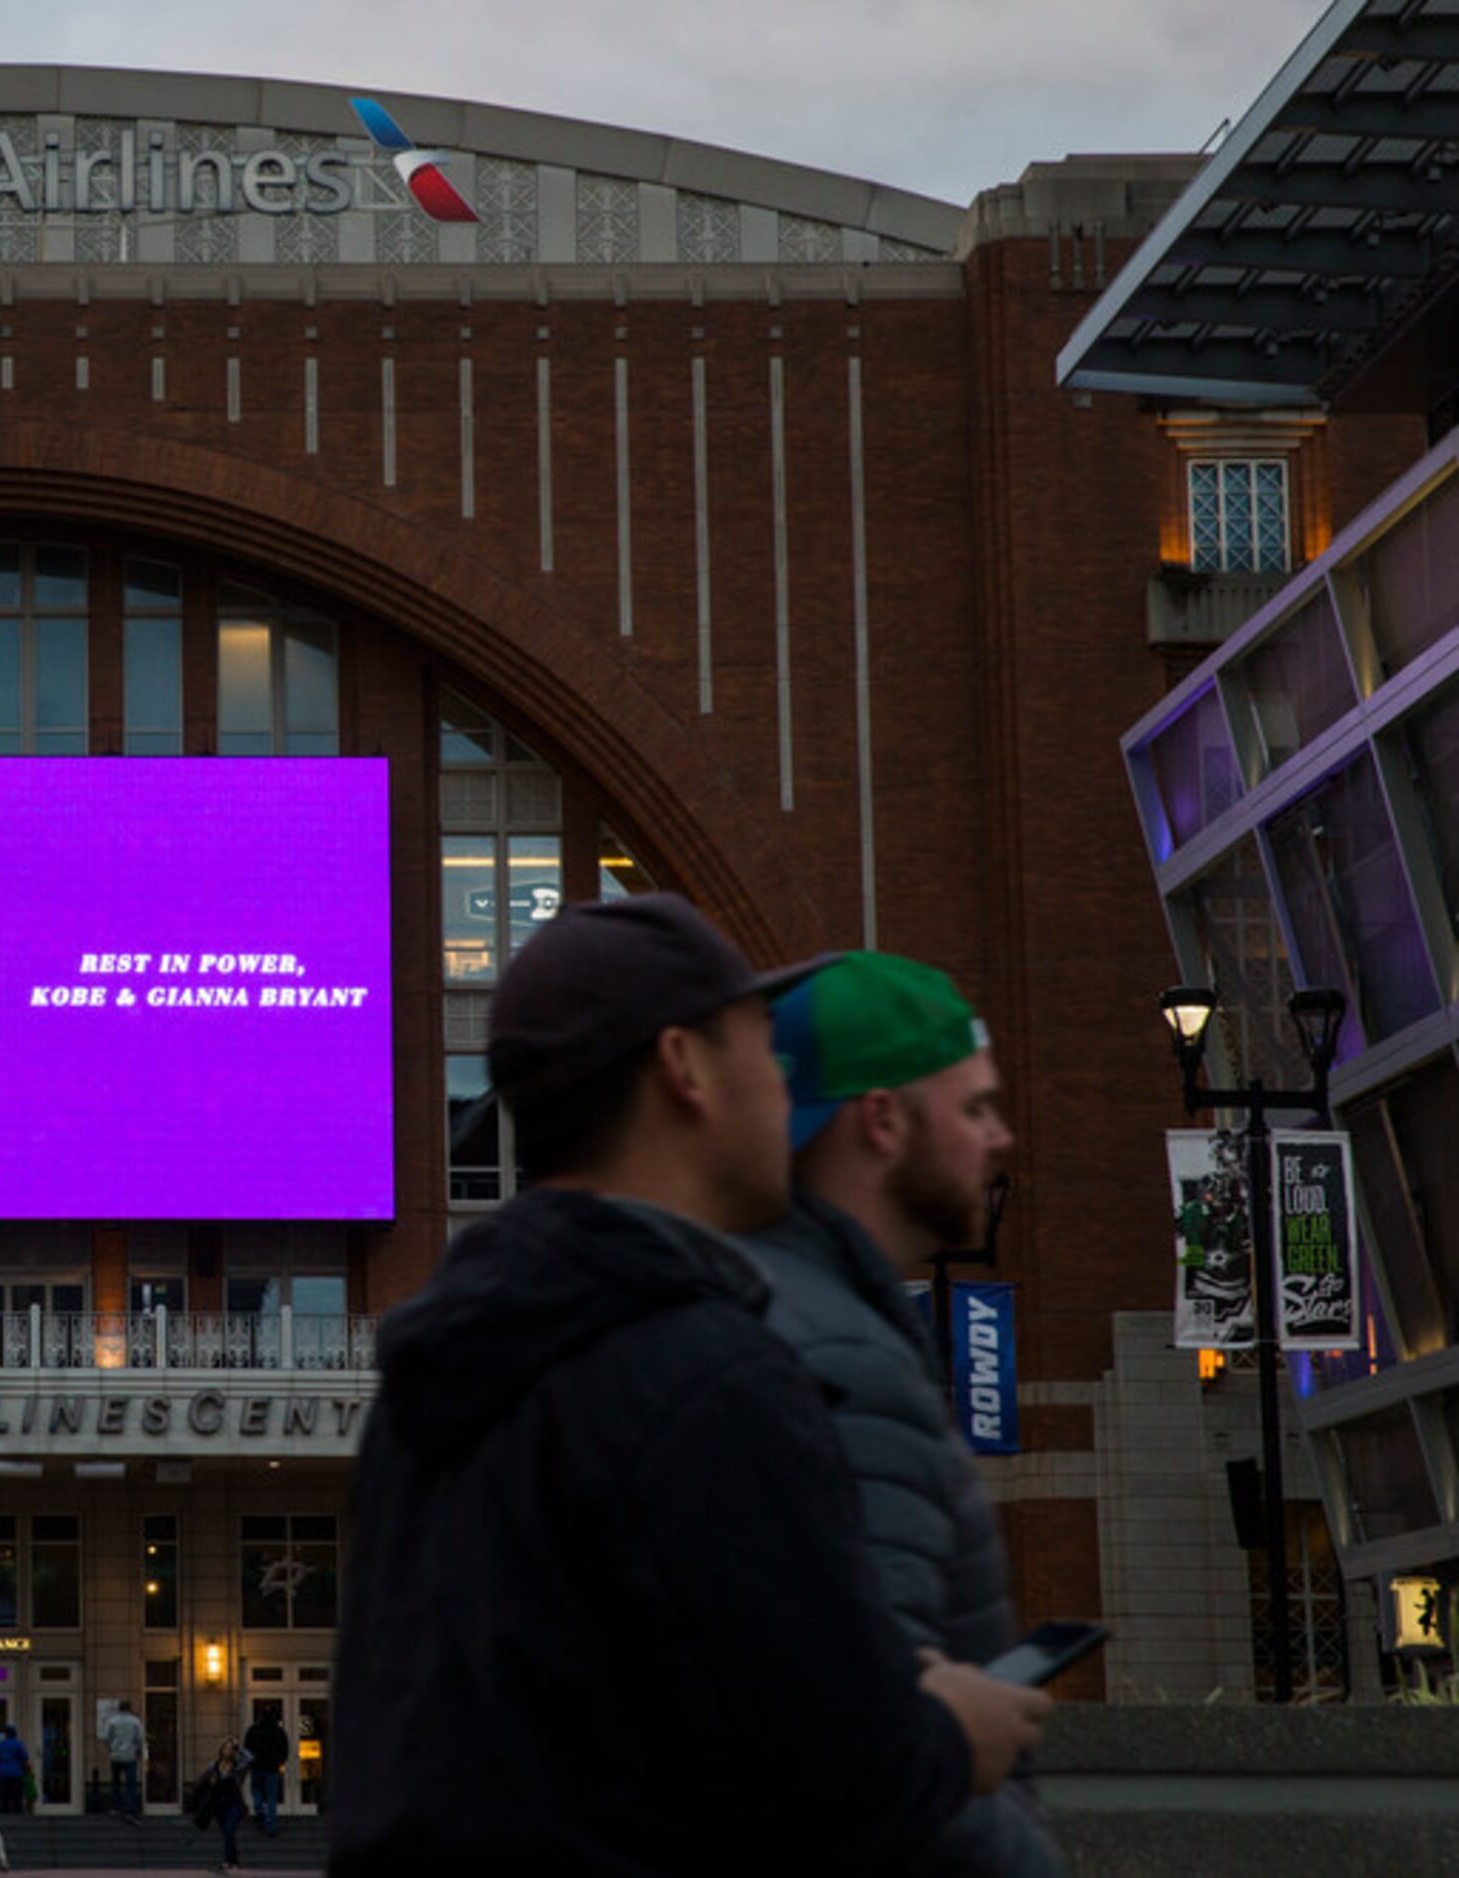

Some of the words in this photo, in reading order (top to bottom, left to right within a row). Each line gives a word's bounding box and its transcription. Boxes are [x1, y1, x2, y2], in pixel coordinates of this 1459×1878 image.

[80, 953, 152, 973] REST
[158, 953, 191, 973] IN
[199, 953, 305, 977] POWER,
[30, 986, 107, 1007] KOBE
[116, 987, 136, 1007] &
[147, 986, 250, 1007] GIANNA
[259, 986, 368, 1007] BRYANT
[1284, 1156, 1303, 1183] BE
[1284, 1184, 1329, 1215] LOUD.
[1286, 1215, 1332, 1244] WEAR
[967, 1295, 1003, 1441] ROWDY
